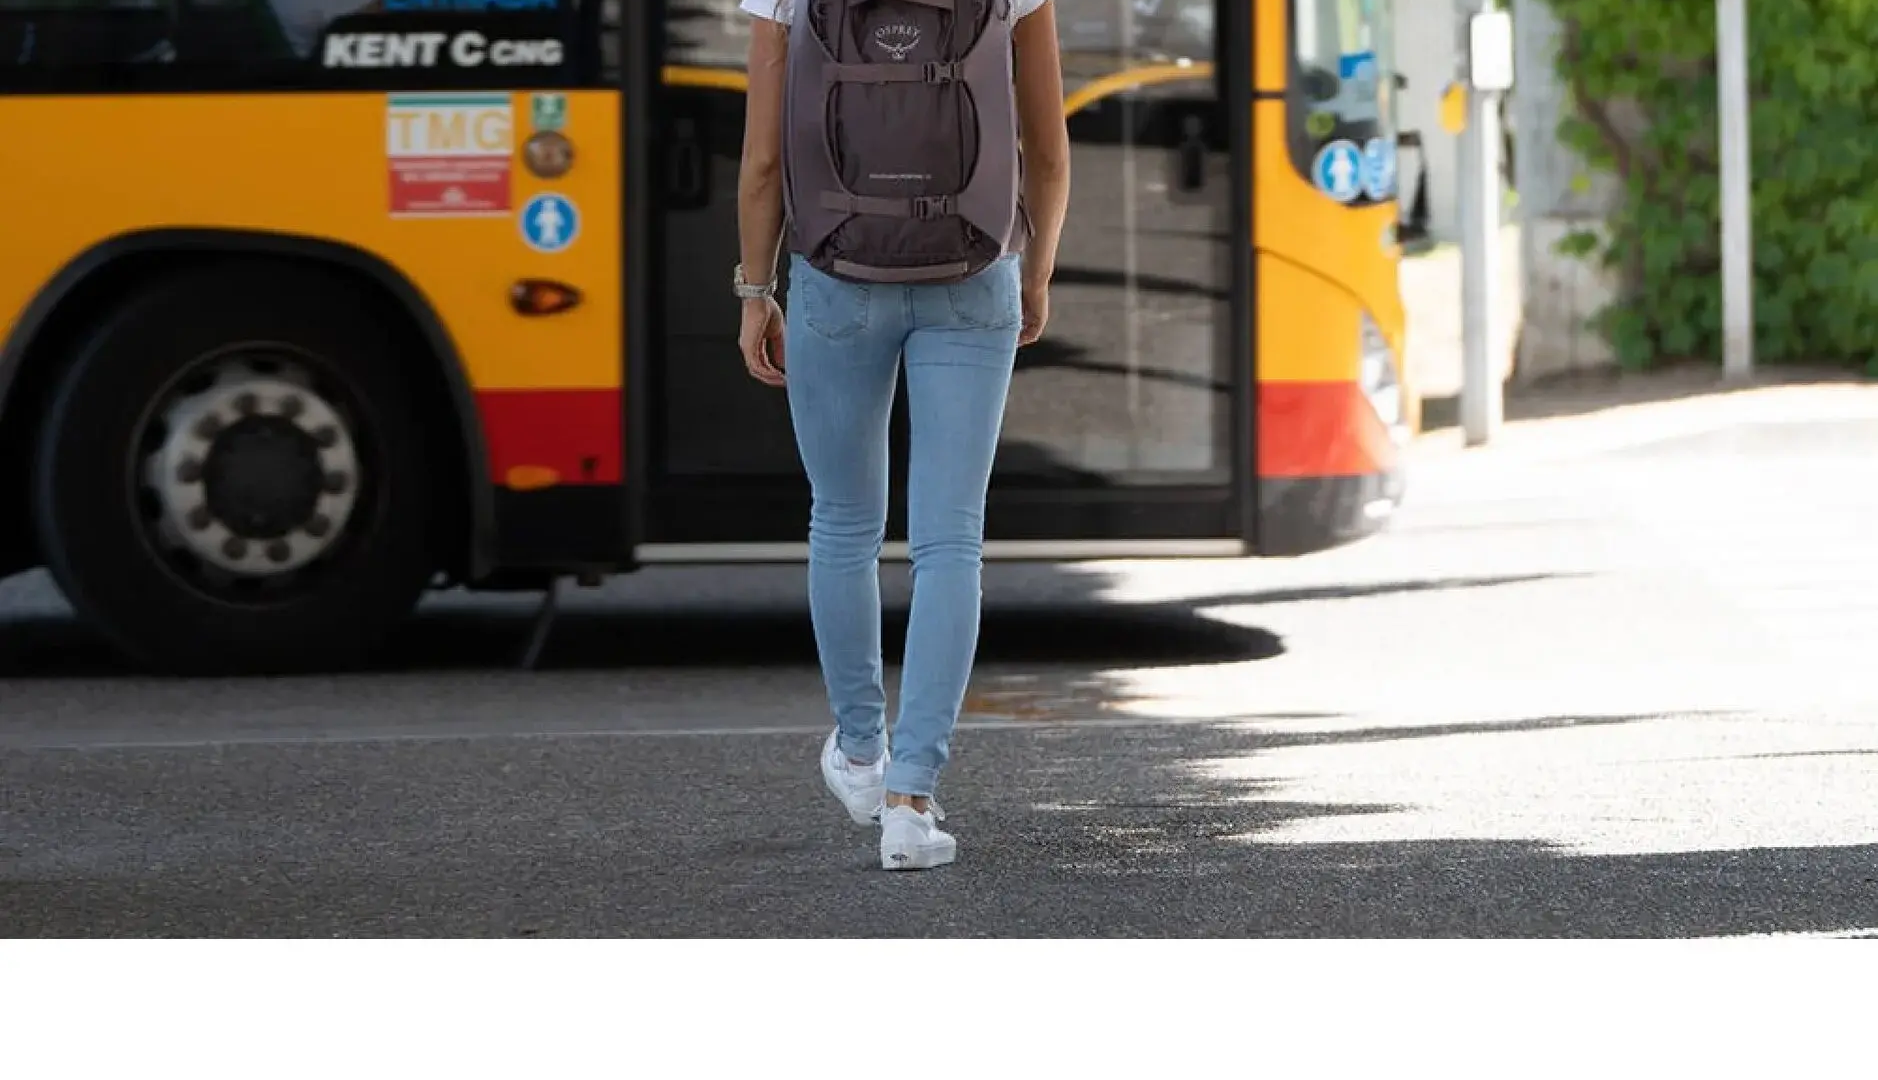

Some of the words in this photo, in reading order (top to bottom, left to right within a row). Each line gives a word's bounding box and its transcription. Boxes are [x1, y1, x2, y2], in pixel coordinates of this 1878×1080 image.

[323, 32, 449, 68] KENT
[451, 30, 488, 67] C
[489, 39, 564, 66] CNG
[390, 111, 513, 150] TMG
